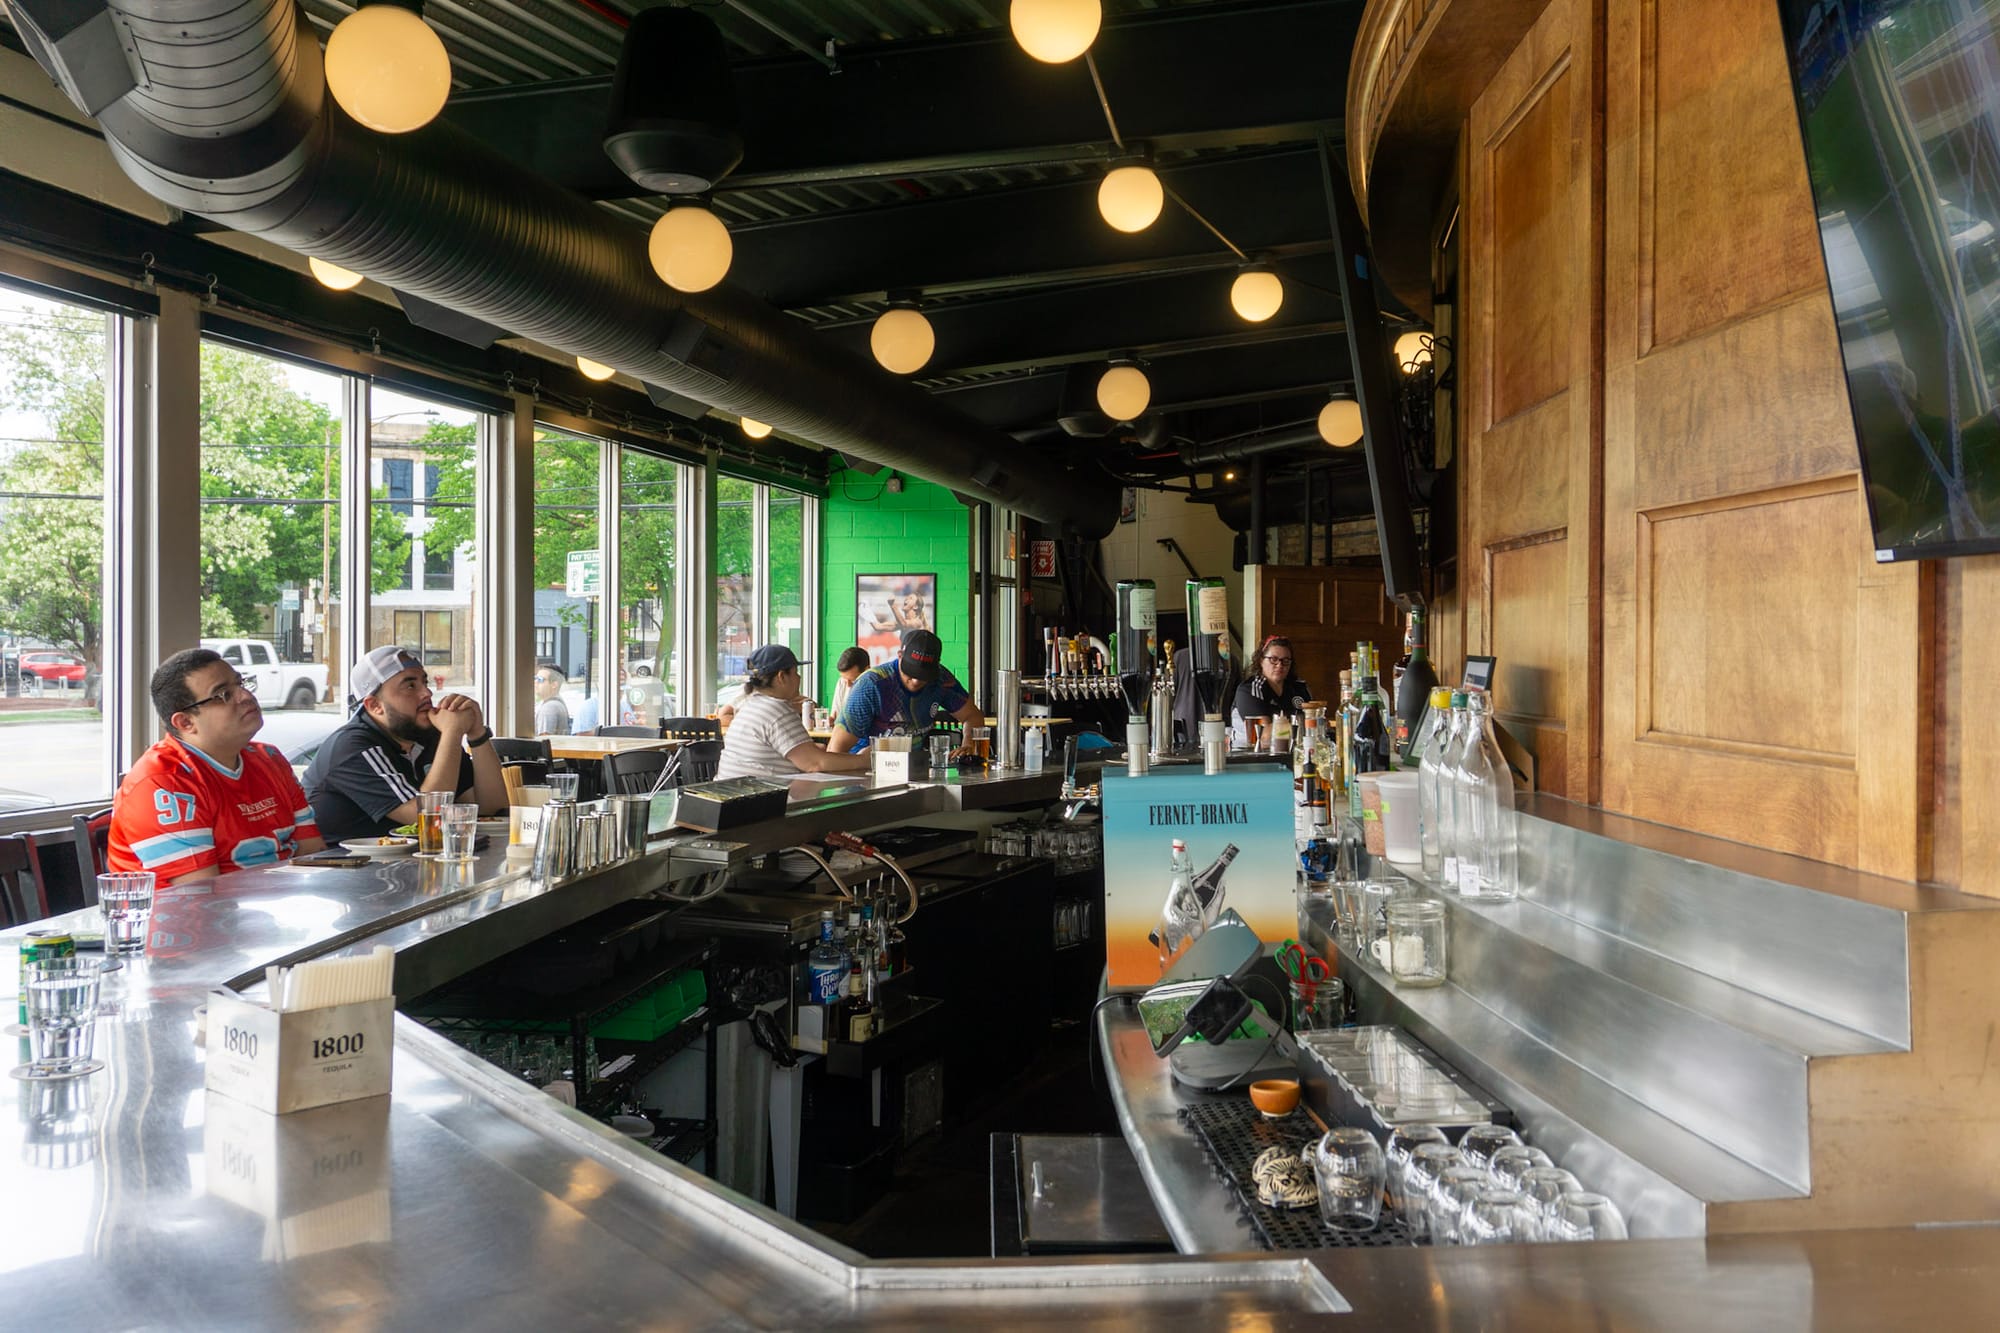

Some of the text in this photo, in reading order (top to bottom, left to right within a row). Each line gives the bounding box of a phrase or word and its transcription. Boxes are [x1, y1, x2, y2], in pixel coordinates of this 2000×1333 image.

[153, 788, 196, 826] 97
[1149, 803, 1248, 826] FERNET-BRANCA
[523, 821, 539, 831] 180
[223, 1025, 257, 1060] 1800
[312, 1032, 364, 1059] 1800
[322, 1063, 353, 1073] TEQUILA
